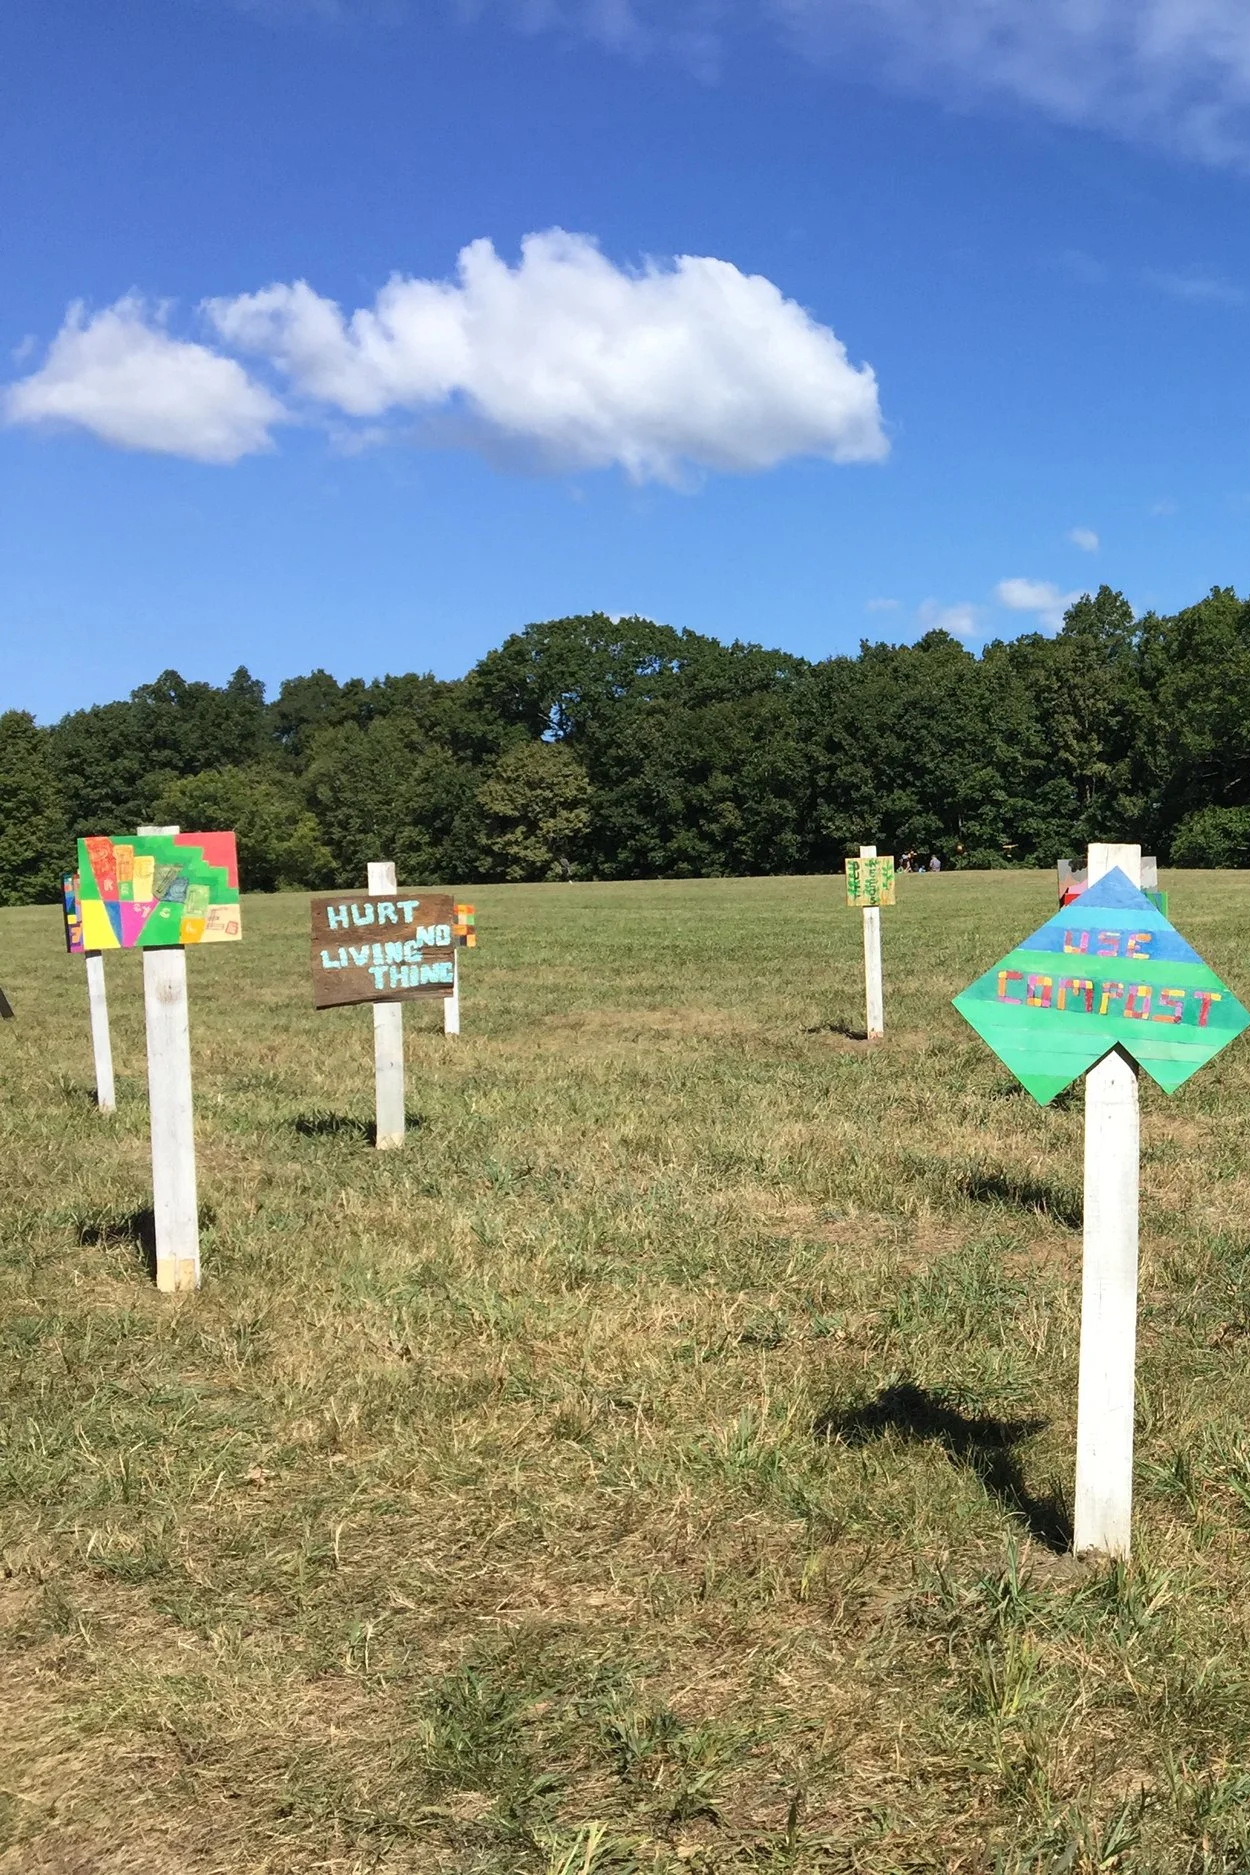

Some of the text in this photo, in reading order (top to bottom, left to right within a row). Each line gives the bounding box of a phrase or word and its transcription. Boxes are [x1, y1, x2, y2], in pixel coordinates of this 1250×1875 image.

[327, 900, 420, 930] HURT
[416, 924, 451, 948] NO
[1063, 930, 1152, 960] USE
[998, 970, 1222, 1028] COMPOST
